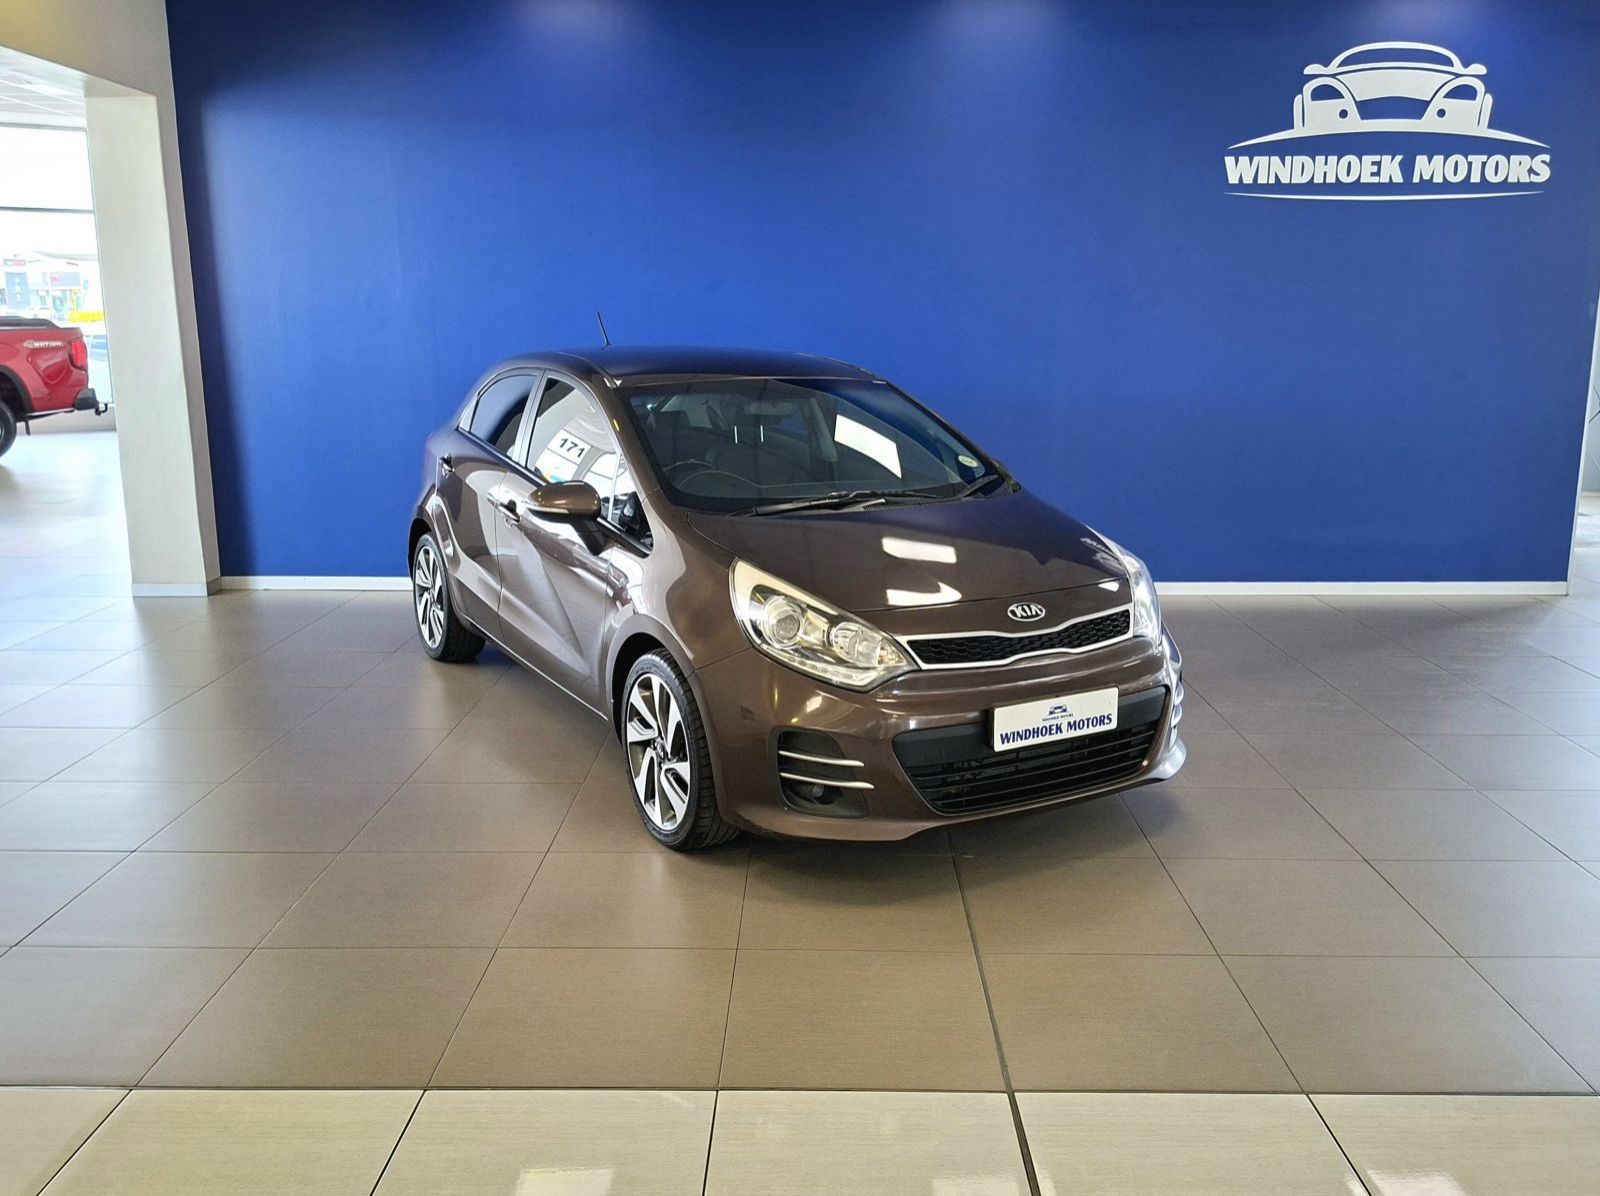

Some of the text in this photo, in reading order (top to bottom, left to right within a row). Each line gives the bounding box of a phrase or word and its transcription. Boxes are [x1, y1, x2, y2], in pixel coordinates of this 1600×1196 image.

[1224, 154, 1551, 184] WINDHOEK MOTORS
[559, 437, 586, 459] 171
[1013, 604, 1042, 618] KIA
[999, 722, 1064, 746] WINDHOEK
[1066, 713, 1113, 733] MOTORS
